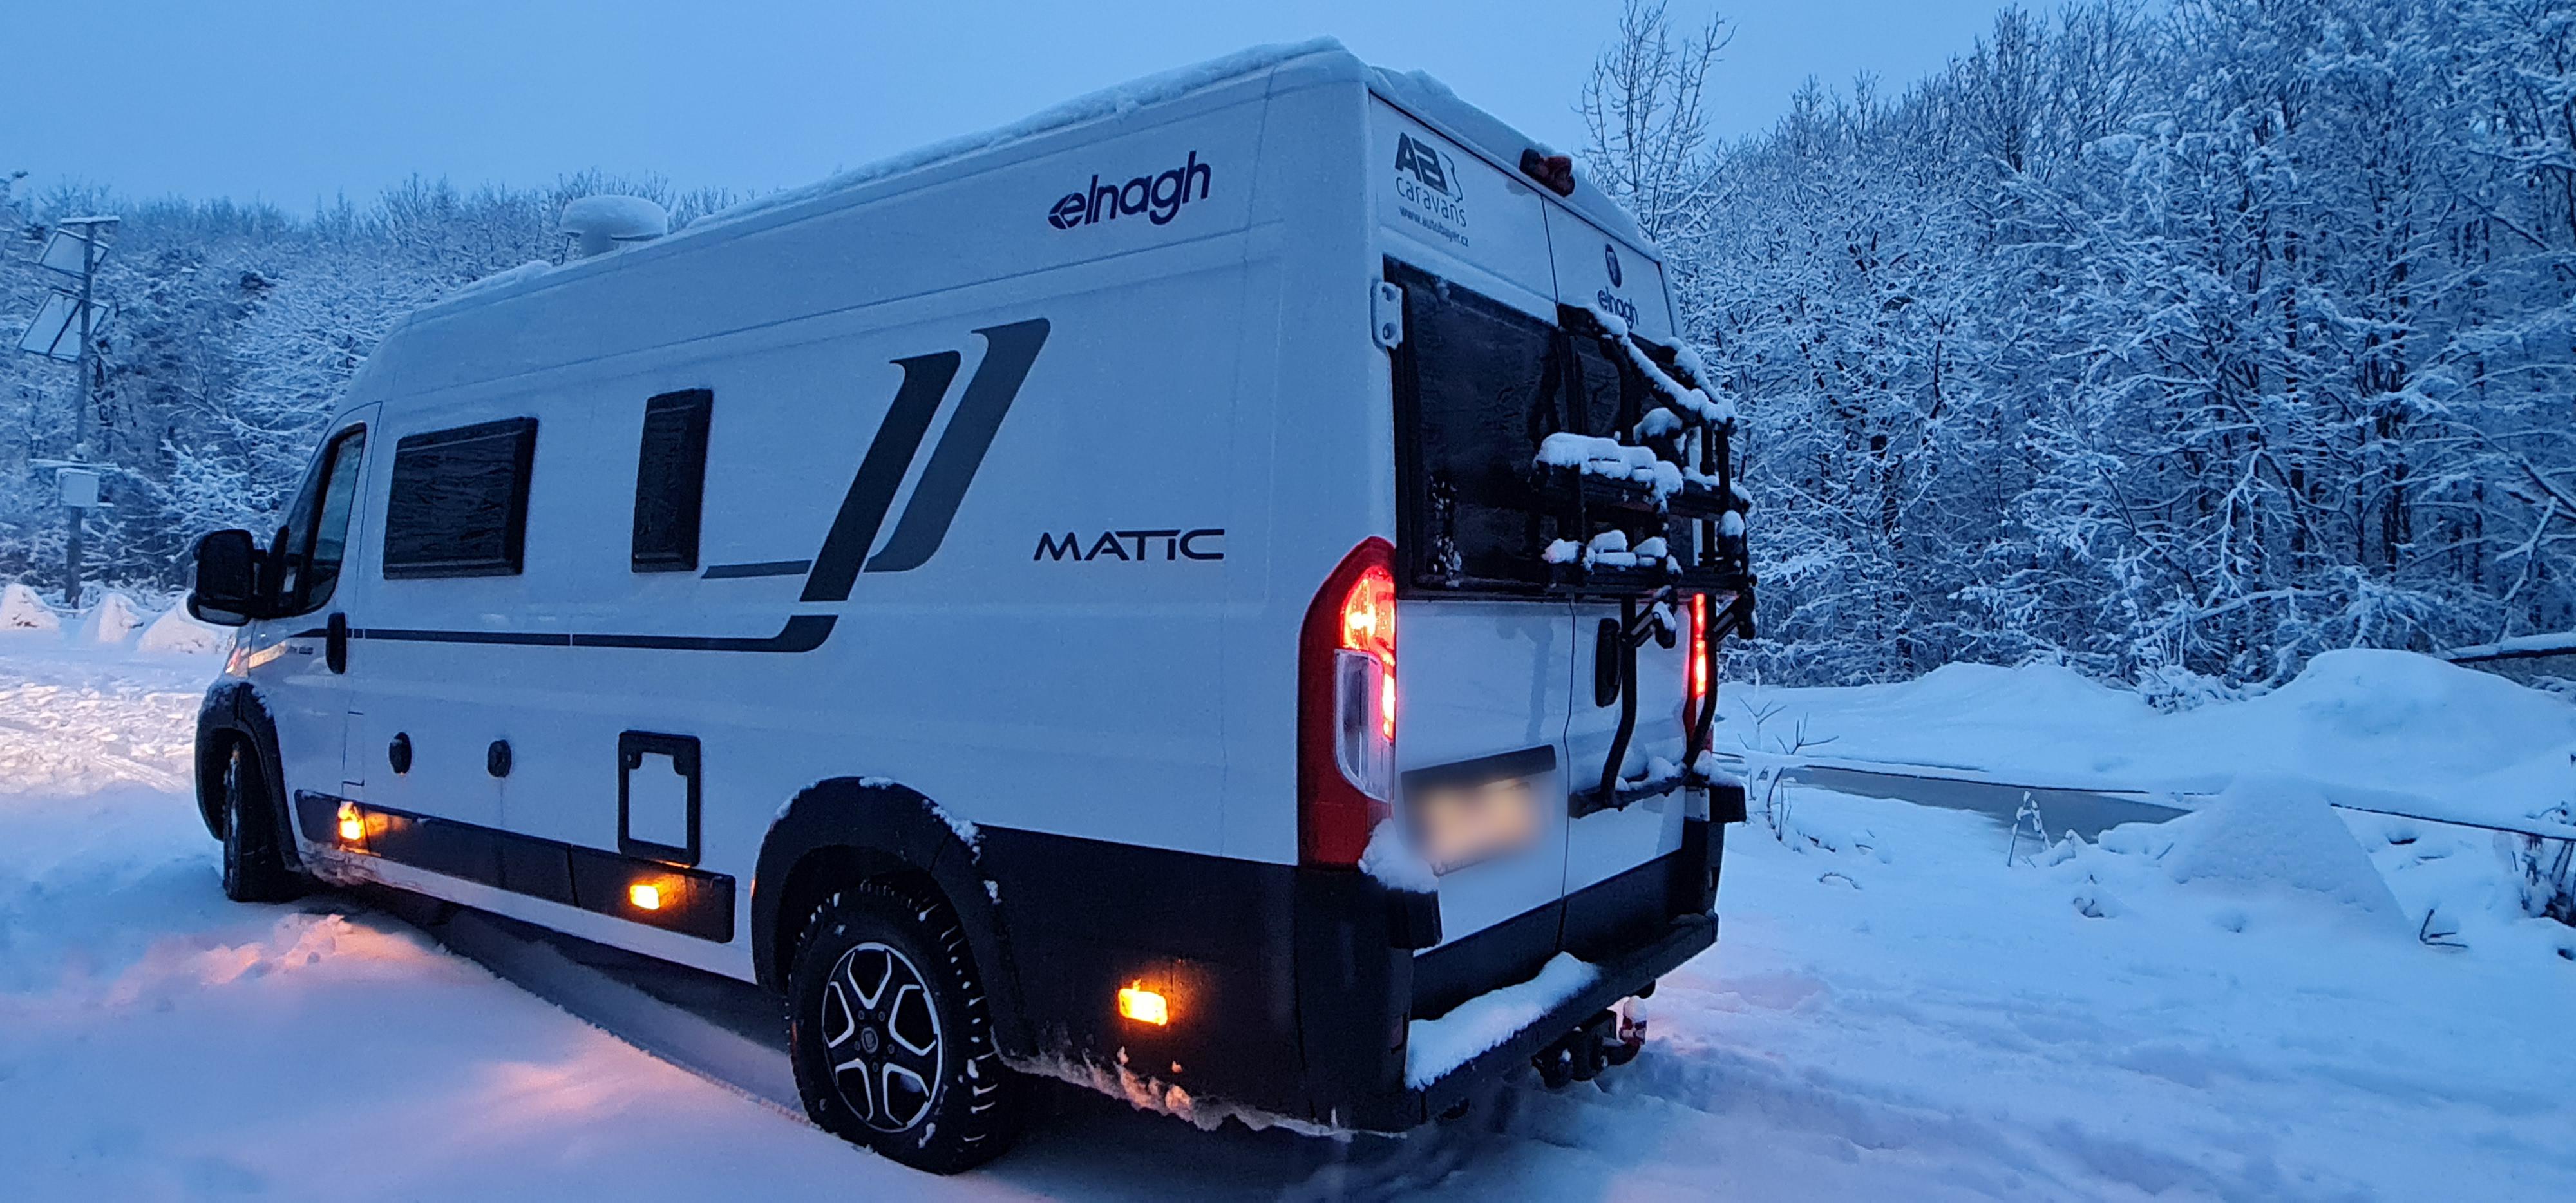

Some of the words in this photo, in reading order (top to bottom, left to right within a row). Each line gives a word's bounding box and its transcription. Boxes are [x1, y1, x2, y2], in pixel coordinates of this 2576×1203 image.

[1048, 150, 1211, 229] elnagh
[1396, 176, 1467, 227] caravans
[1598, 286, 1639, 329] elnagh
